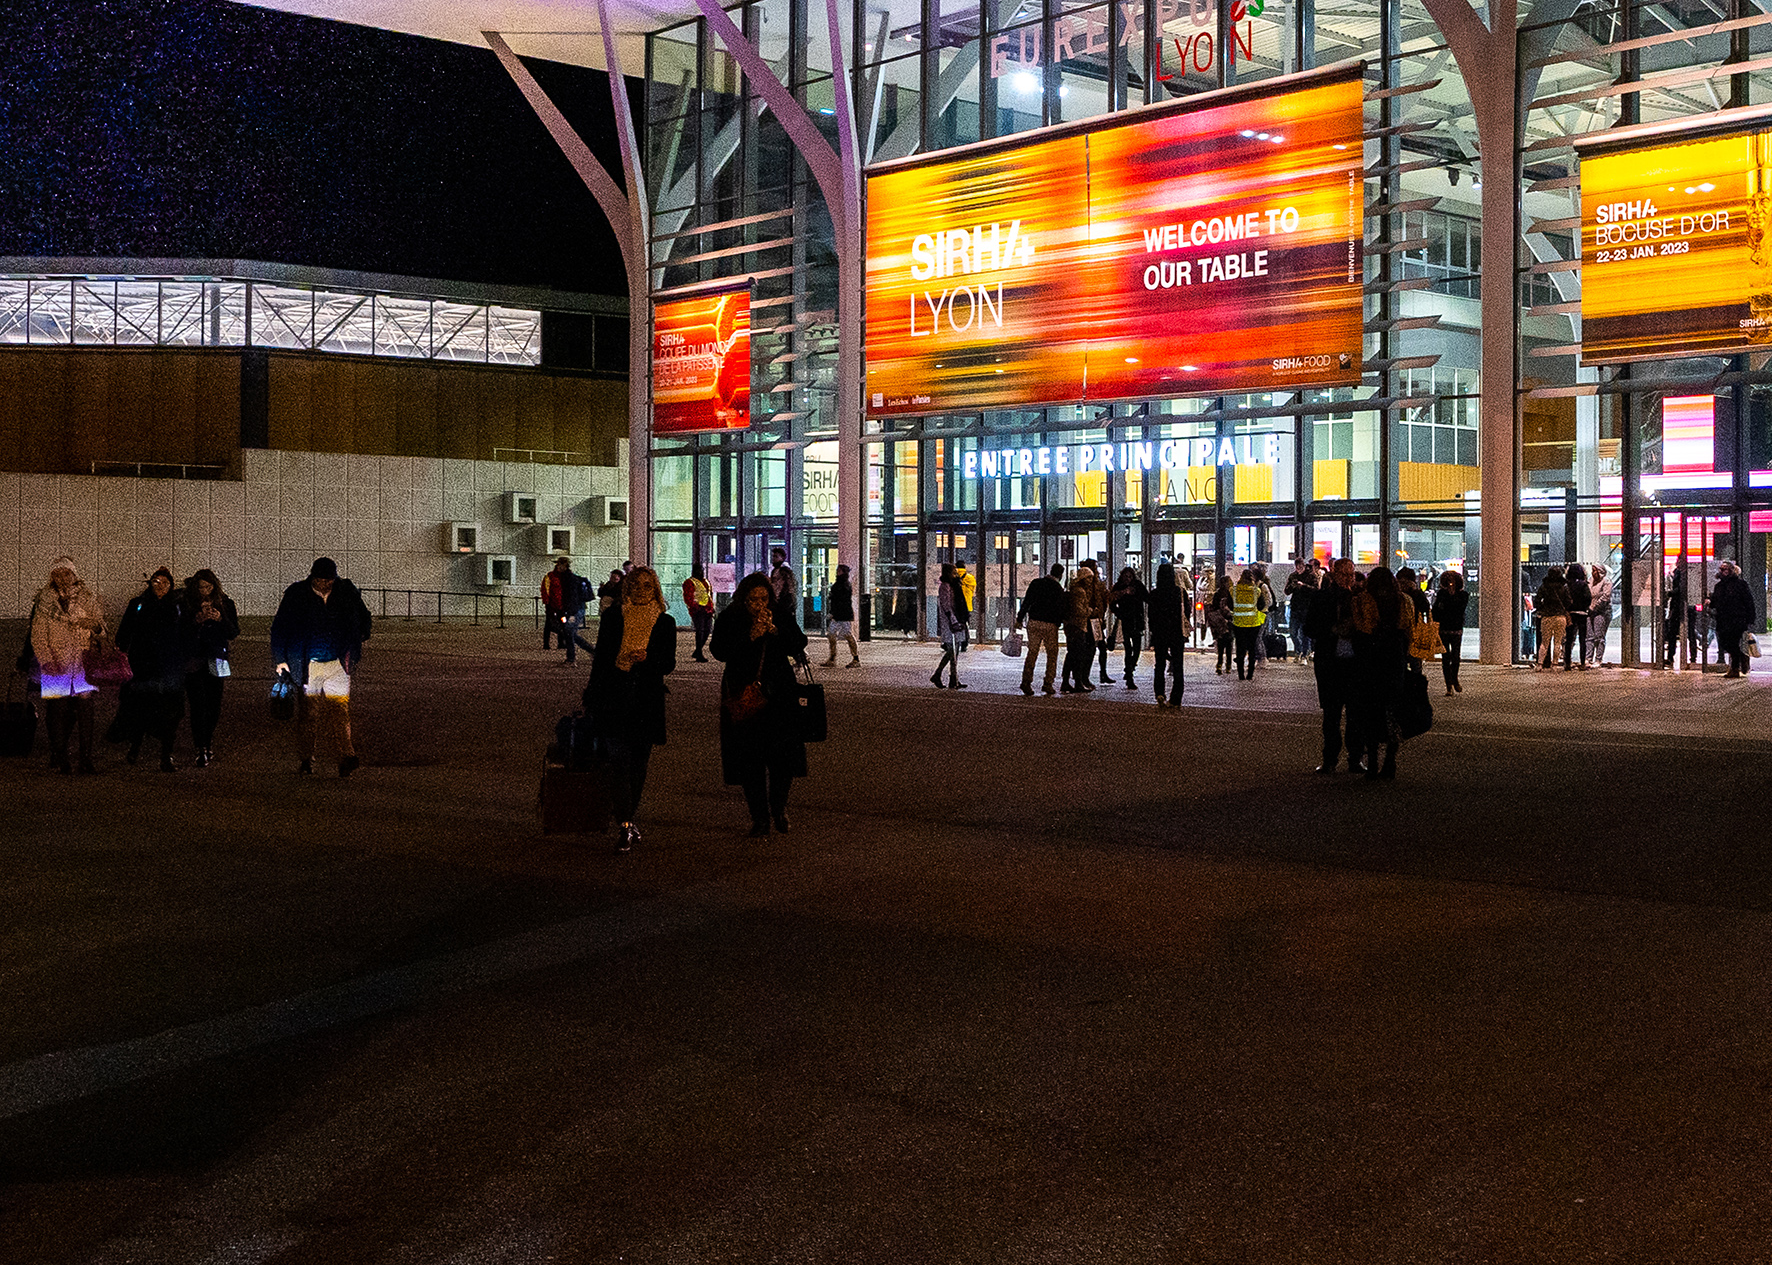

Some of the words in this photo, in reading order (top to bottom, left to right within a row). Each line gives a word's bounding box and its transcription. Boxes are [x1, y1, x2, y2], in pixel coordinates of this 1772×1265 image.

[1155, 21, 1253, 82] LYON
[1143, 212, 1260, 252] WELCOME
[1265, 207, 1299, 235] TO
[1596, 217, 1675, 246] BOCUSE
[1680, 210, 1730, 235] D'OR
[1143, 261, 1192, 290] OUR
[1197, 250, 1269, 284] TABLE
[1596, 249, 1628, 263] 22-23
[1630, 245, 1658, 260] JAN.
[1660, 241, 1690, 256] 2023
[911, 282, 1003, 336] LYON
[1304, 354, 1331, 367] FOOD
[964, 446, 1070, 478] ENTREE
[1080, 434, 1280, 473] PRINCIPALE
